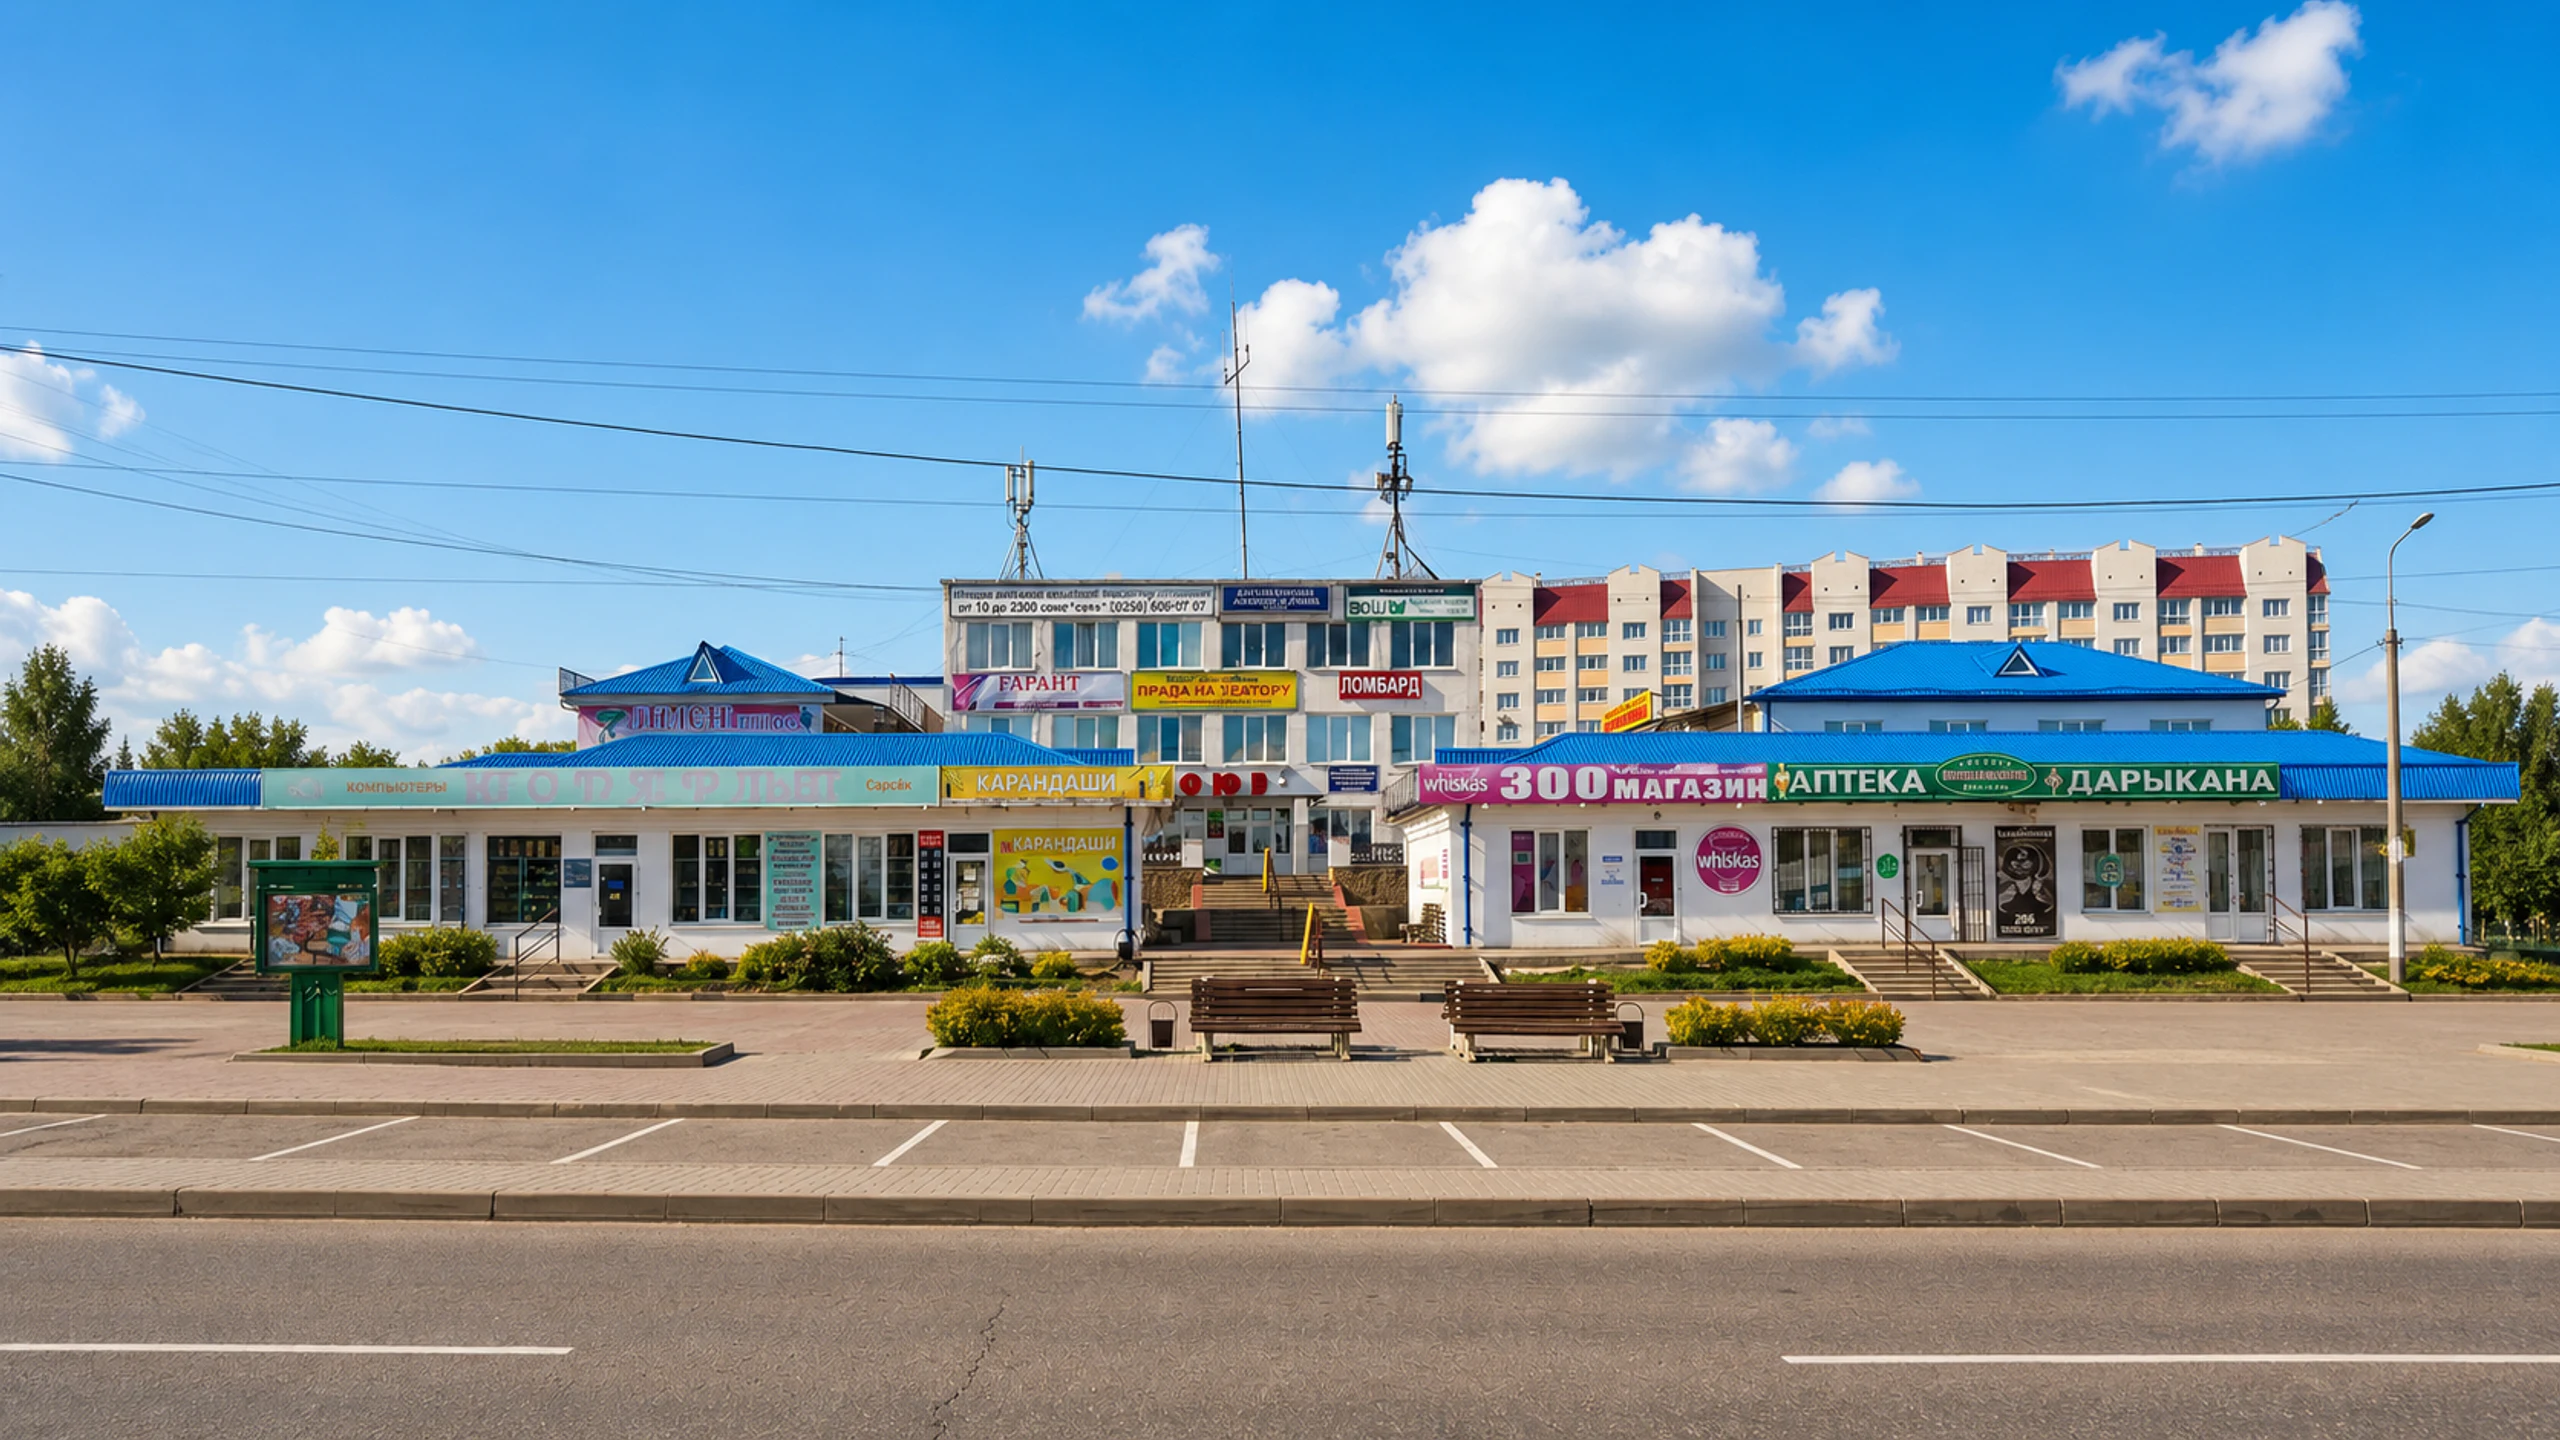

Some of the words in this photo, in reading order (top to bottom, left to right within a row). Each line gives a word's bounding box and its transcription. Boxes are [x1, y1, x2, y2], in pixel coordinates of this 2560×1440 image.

[976, 601, 989, 613] 10
[1195, 684, 1215, 696] НА
[1341, 676, 1420, 697] ЛОМБАРД
[976, 773, 1117, 795] КАРАНДАШИ
[1423, 768, 1489, 792] whiskas
[1500, 766, 1608, 800] 300
[1614, 778, 1767, 800] МАГАЗИН
[1788, 769, 1927, 794] АПТЕКА
[2066, 769, 2276, 796] ДАРЫКАНА
[1013, 835, 1117, 854] КАРАНДАШИ
